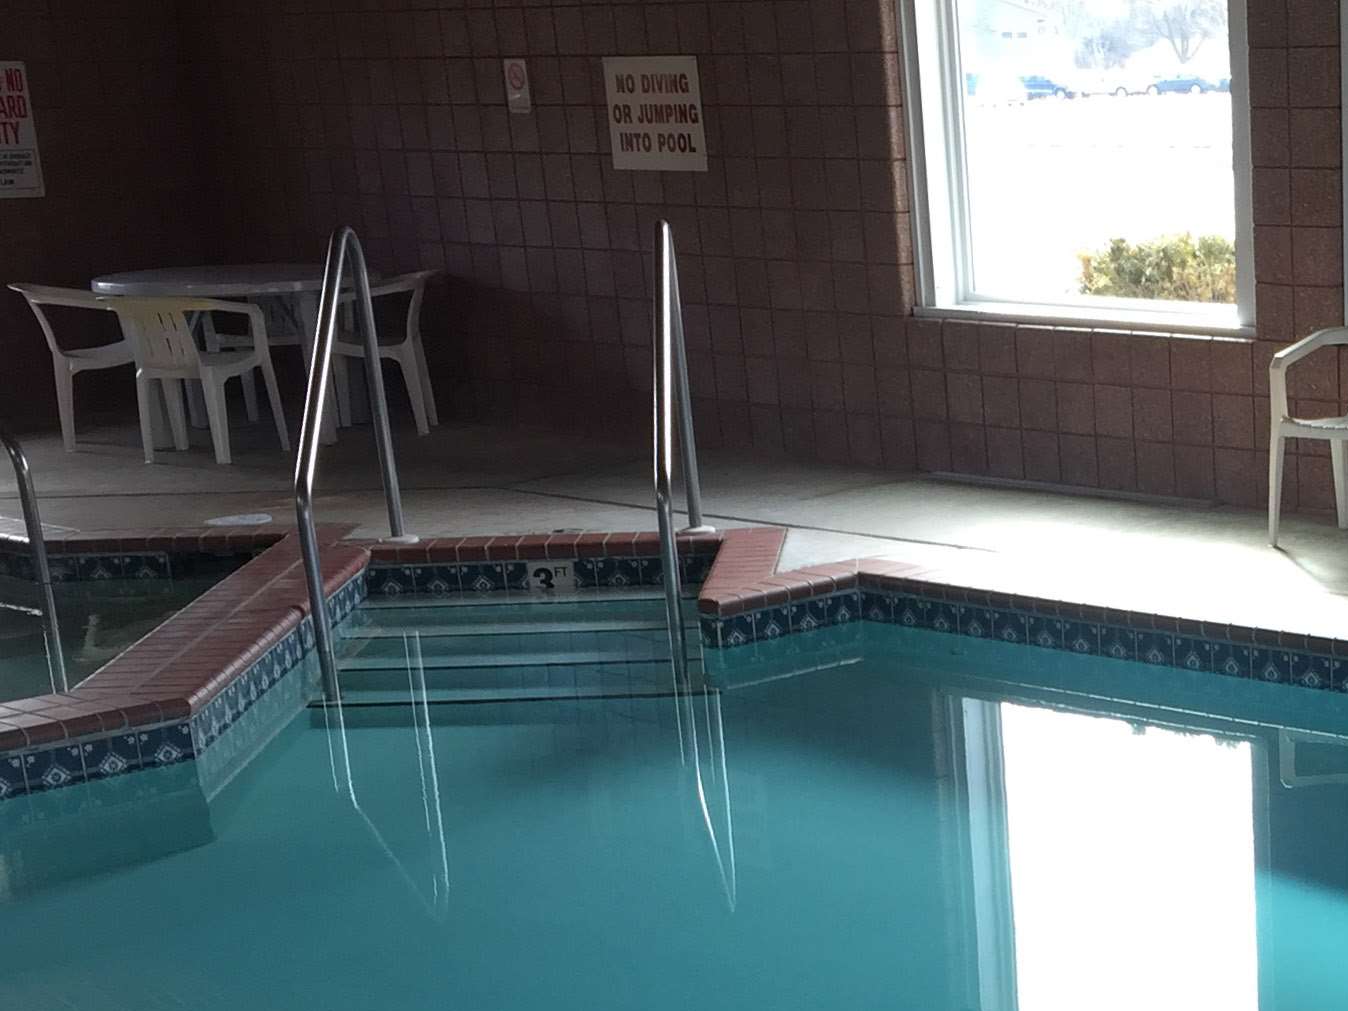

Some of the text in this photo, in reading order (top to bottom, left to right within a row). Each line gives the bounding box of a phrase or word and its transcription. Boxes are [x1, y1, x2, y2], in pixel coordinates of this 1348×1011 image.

[5, 67, 23, 92] NO
[615, 73, 690, 94] NO DIVING
[613, 103, 699, 124] OR JUMPING
[620, 132, 697, 153] INTO POOL
